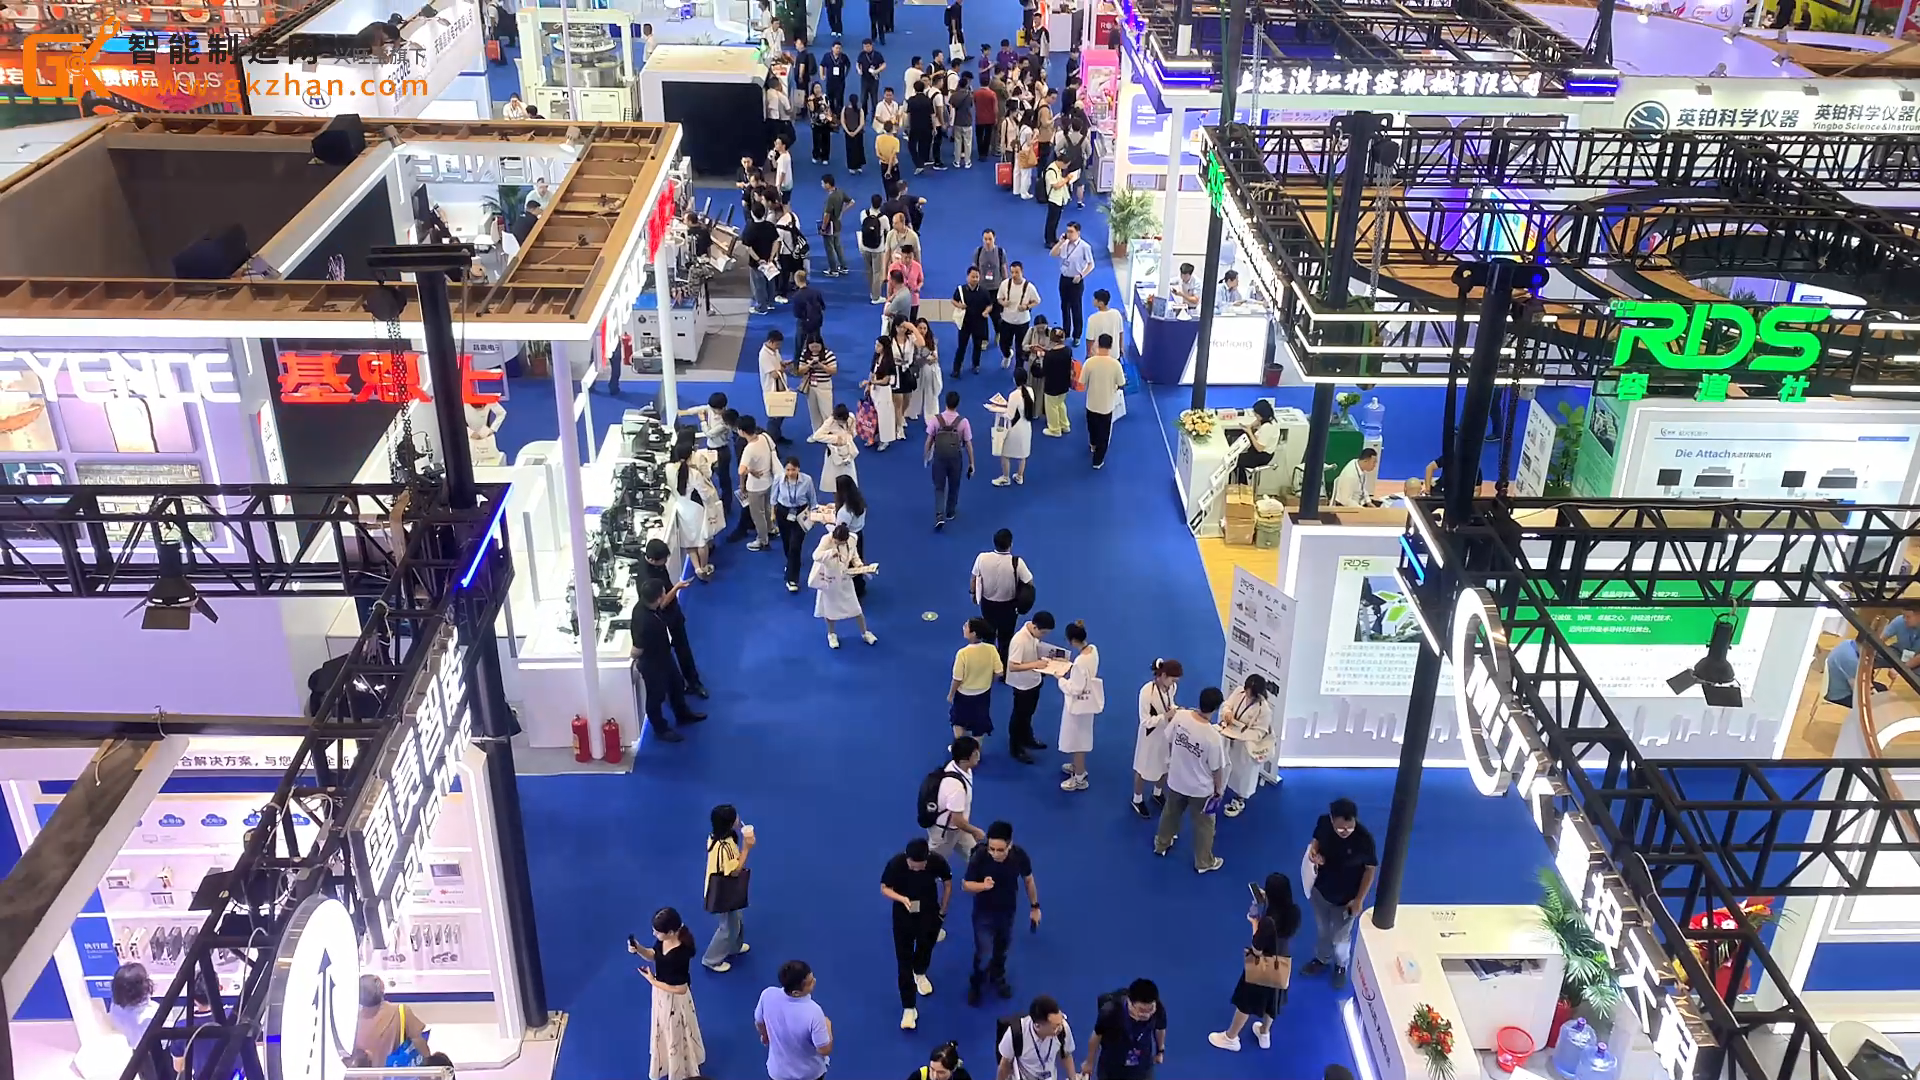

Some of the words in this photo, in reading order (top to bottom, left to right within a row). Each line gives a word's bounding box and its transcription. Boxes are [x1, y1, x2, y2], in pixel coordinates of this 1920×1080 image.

[172, 67, 222, 95] igus
[1677, 108, 1800, 129] 英铂科学仪器
[1815, 104, 1920, 123] 英铂科学仪器(
[1813, 122, 1843, 131] Yingbo
[1613, 301, 1832, 372] RDS
[1618, 371, 1811, 403] 容道社
[1675, 448, 1693, 458] Die
[1695, 448, 1731, 459] Attach
[1343, 559, 1371, 567] RDS
